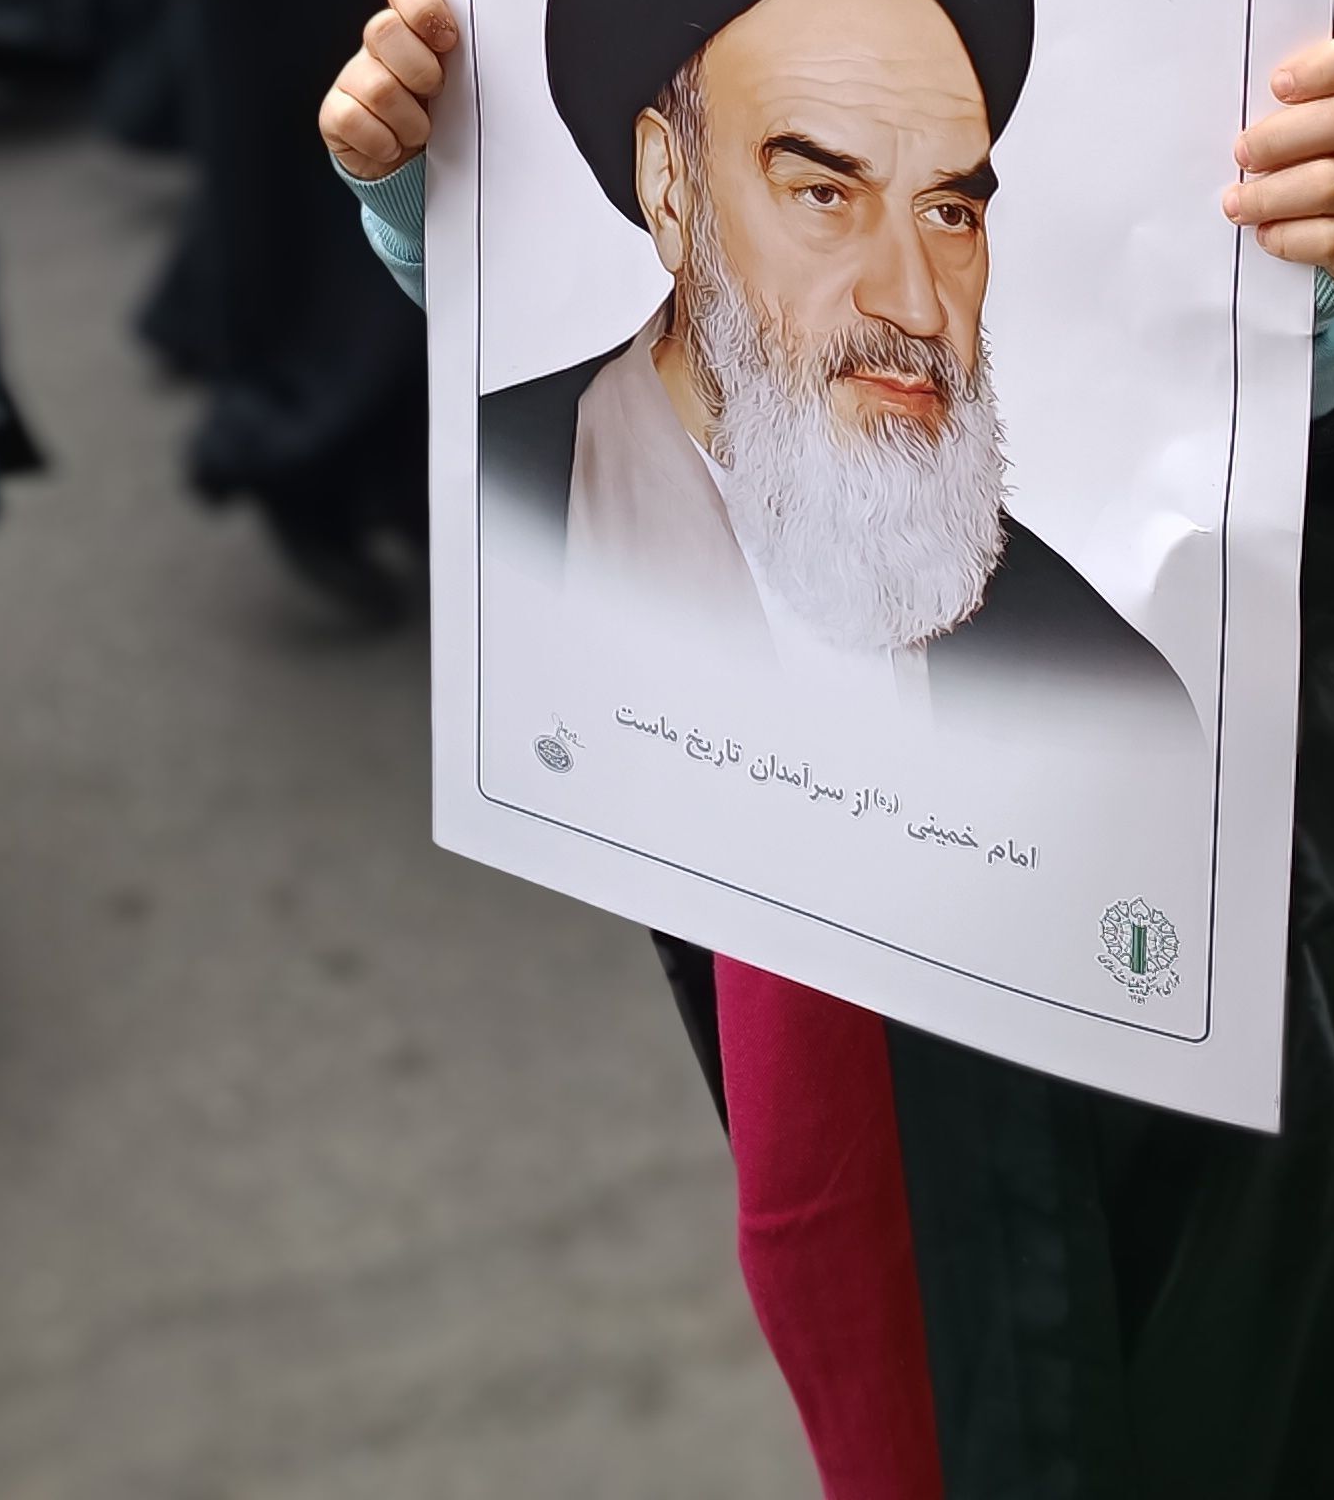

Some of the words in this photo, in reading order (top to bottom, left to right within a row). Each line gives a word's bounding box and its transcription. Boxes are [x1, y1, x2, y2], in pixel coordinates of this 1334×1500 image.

[615, 706, 678, 743] ماست
[685, 727, 743, 767] تاریخ
[851, 787, 869, 817] از
[907, 815, 980, 848] خمینی
[986, 839, 1037, 869] امام
